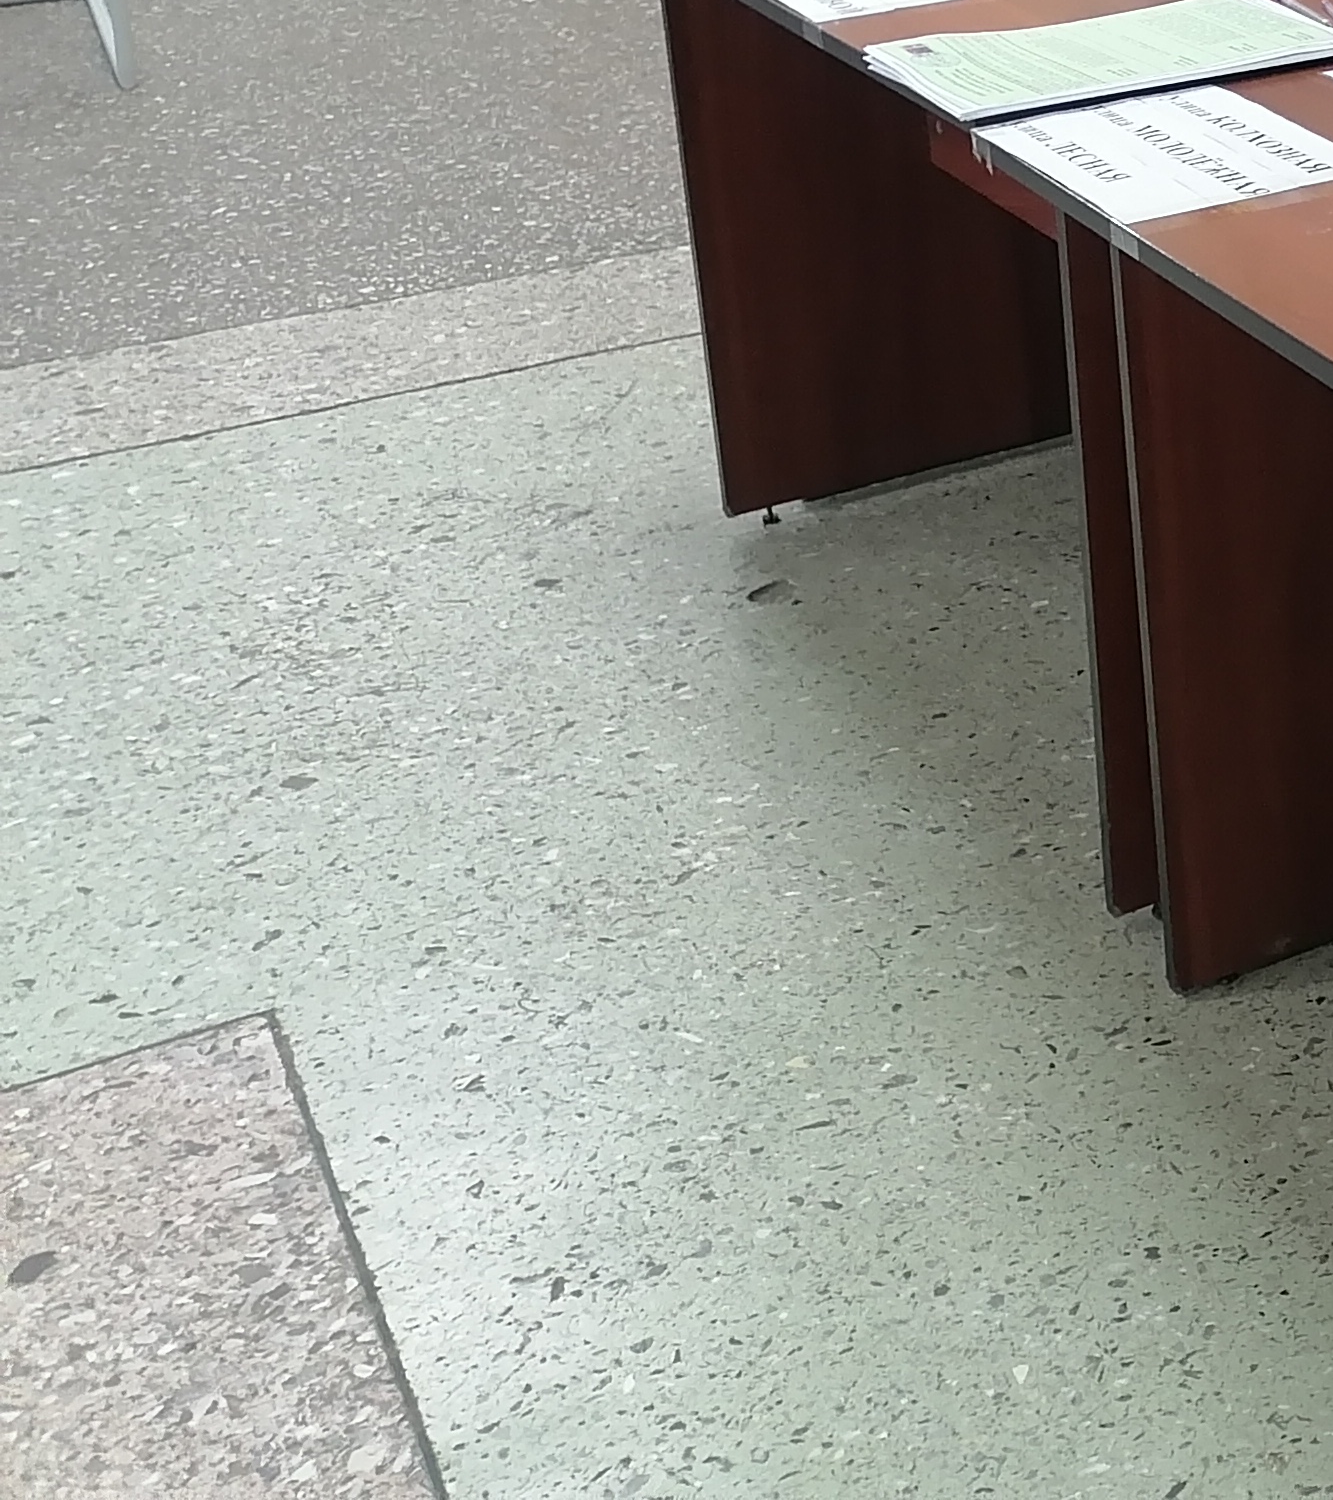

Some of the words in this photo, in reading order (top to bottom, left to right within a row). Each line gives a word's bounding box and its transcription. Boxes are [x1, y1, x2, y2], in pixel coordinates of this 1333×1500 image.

[1046, 140, 1132, 184] ЛЕСНАЯ
[1127, 124, 1271, 197] МОЛОДЁЖНАЯ
[1207, 115, 1333, 175] КОЛХОЗНАЯ
